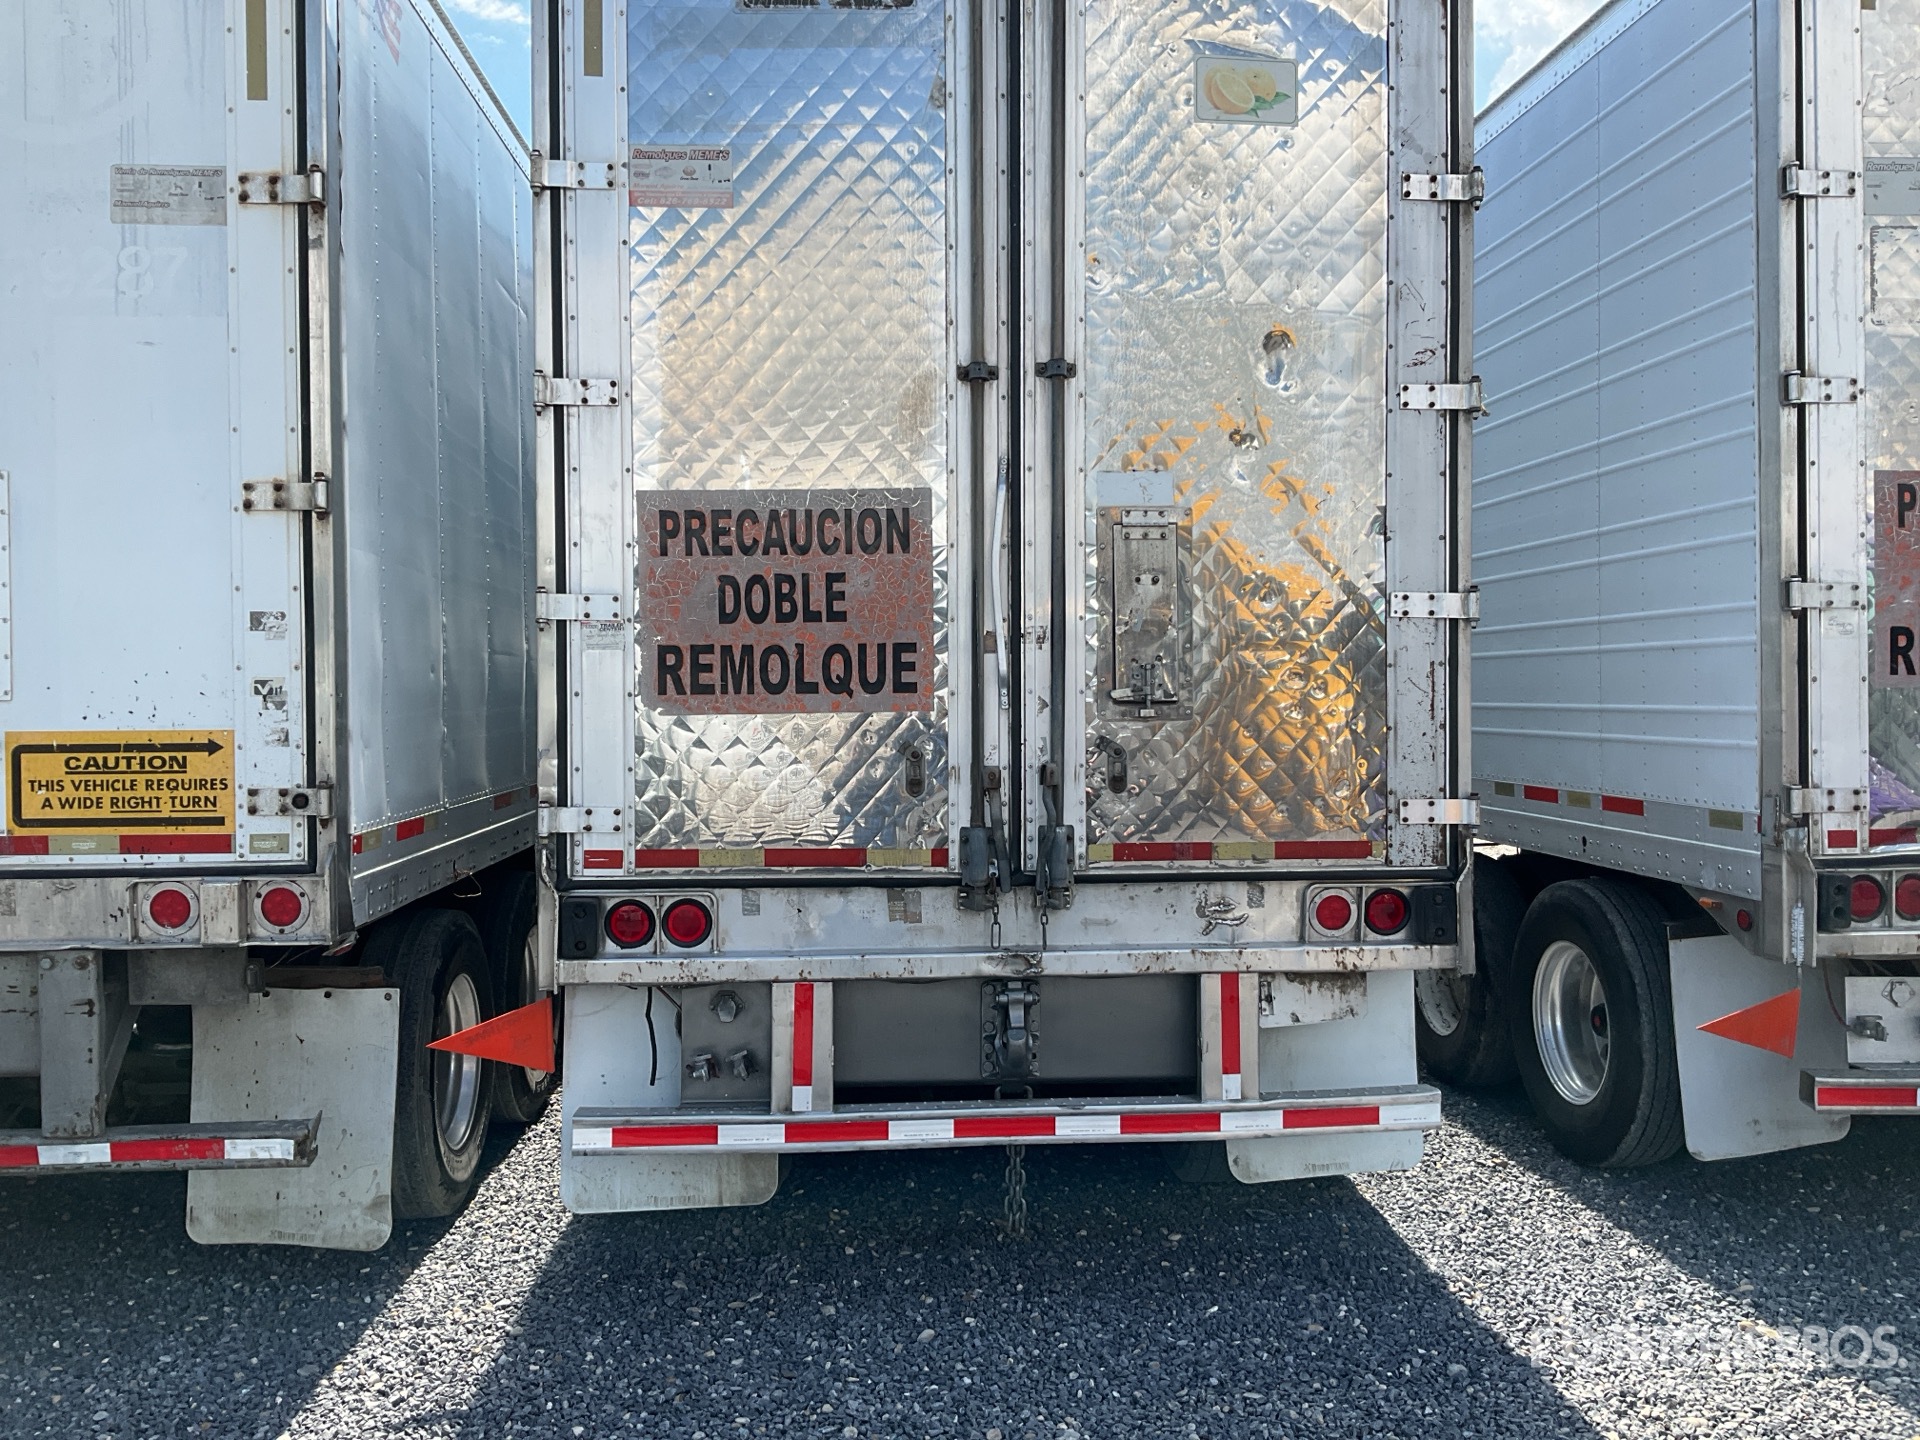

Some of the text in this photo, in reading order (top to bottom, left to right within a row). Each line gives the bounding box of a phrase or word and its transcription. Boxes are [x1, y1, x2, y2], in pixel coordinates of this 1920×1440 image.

[632, 149, 687, 162] Remolques
[137, 167, 148, 176] de
[1866, 161, 1915, 174] Remolques
[658, 508, 910, 556] PRECAUCION
[717, 572, 848, 624] DOBLE
[657, 643, 918, 699] REMOLQUE
[64, 755, 187, 770] CAUTION
[28, 778, 229, 792] THIS VEHICLE REQUIRES
[41, 795, 217, 810] A WIDE RIGHT TURN
